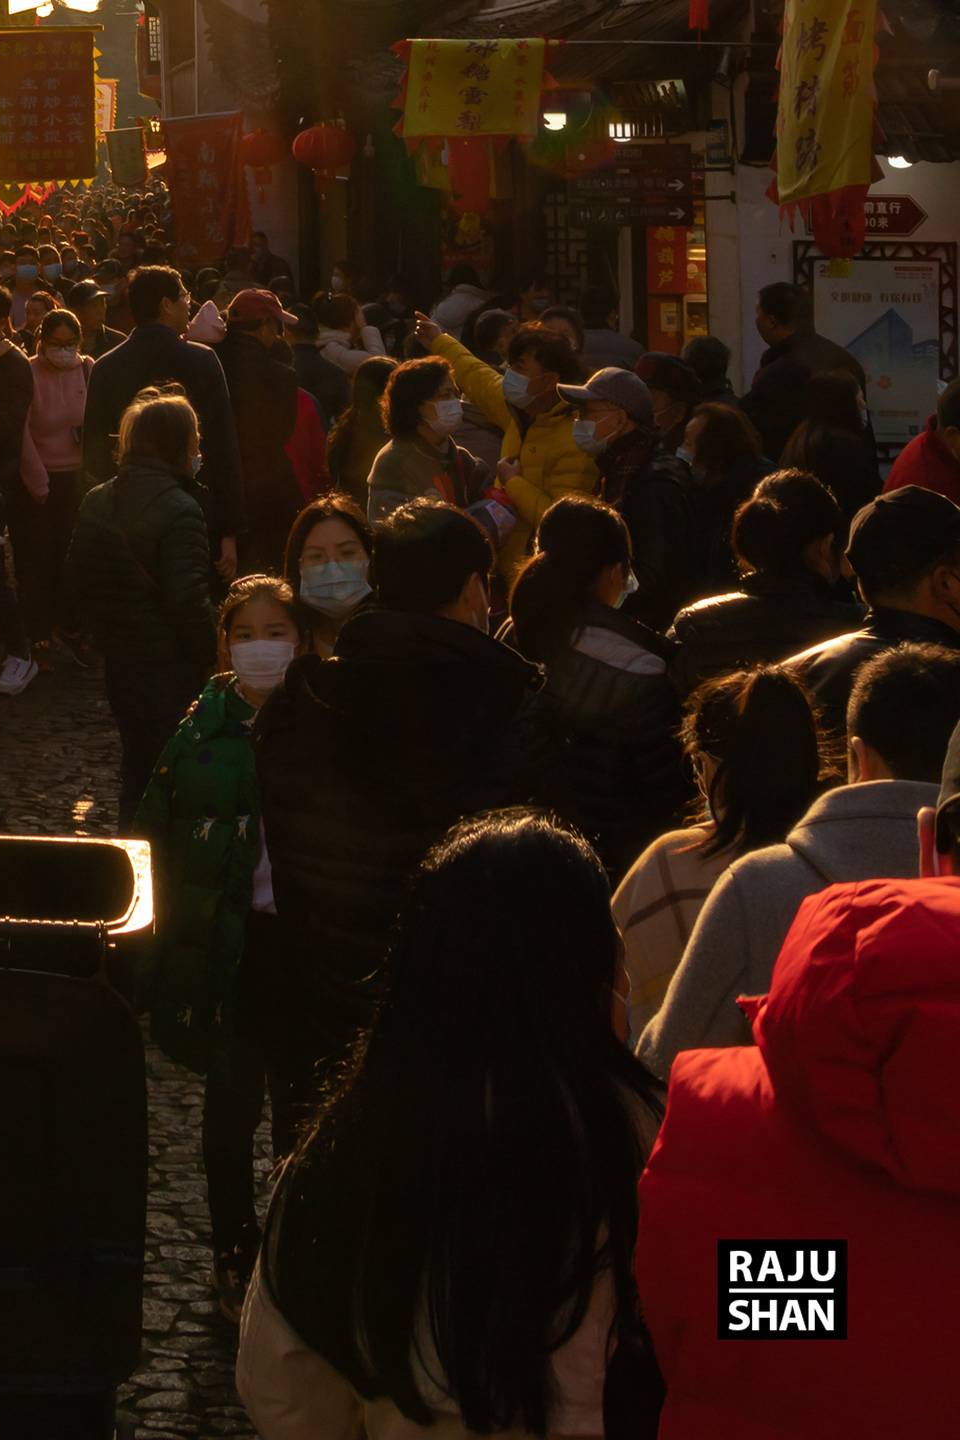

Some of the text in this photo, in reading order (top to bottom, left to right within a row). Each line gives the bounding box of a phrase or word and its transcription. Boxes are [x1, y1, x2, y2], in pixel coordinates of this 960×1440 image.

[20, 77, 61, 91] 主营
[455, 41, 499, 131] 冰糖雪梨
